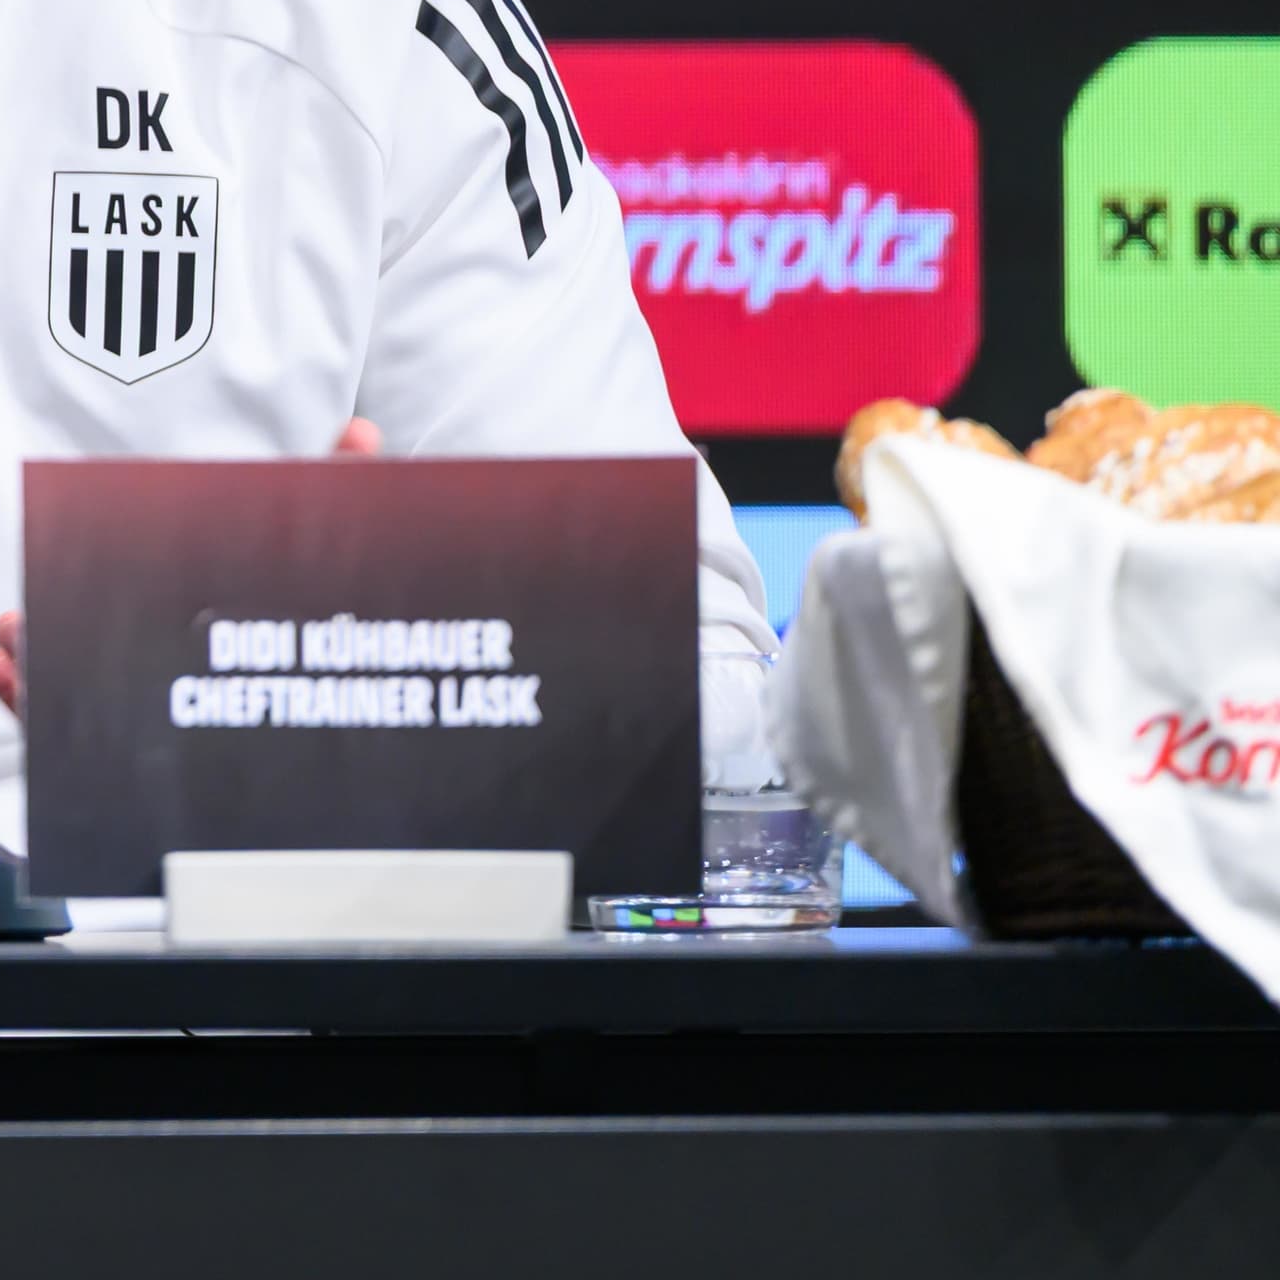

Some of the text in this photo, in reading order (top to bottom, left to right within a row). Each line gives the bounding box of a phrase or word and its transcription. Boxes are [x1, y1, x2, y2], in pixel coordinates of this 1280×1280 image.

[96, 86, 174, 152] DK
[71, 192, 200, 238] LASK
[208, 612, 514, 671] DIDI KÜHBAUER
[170, 674, 542, 728] CHEFTRAINER LASK
